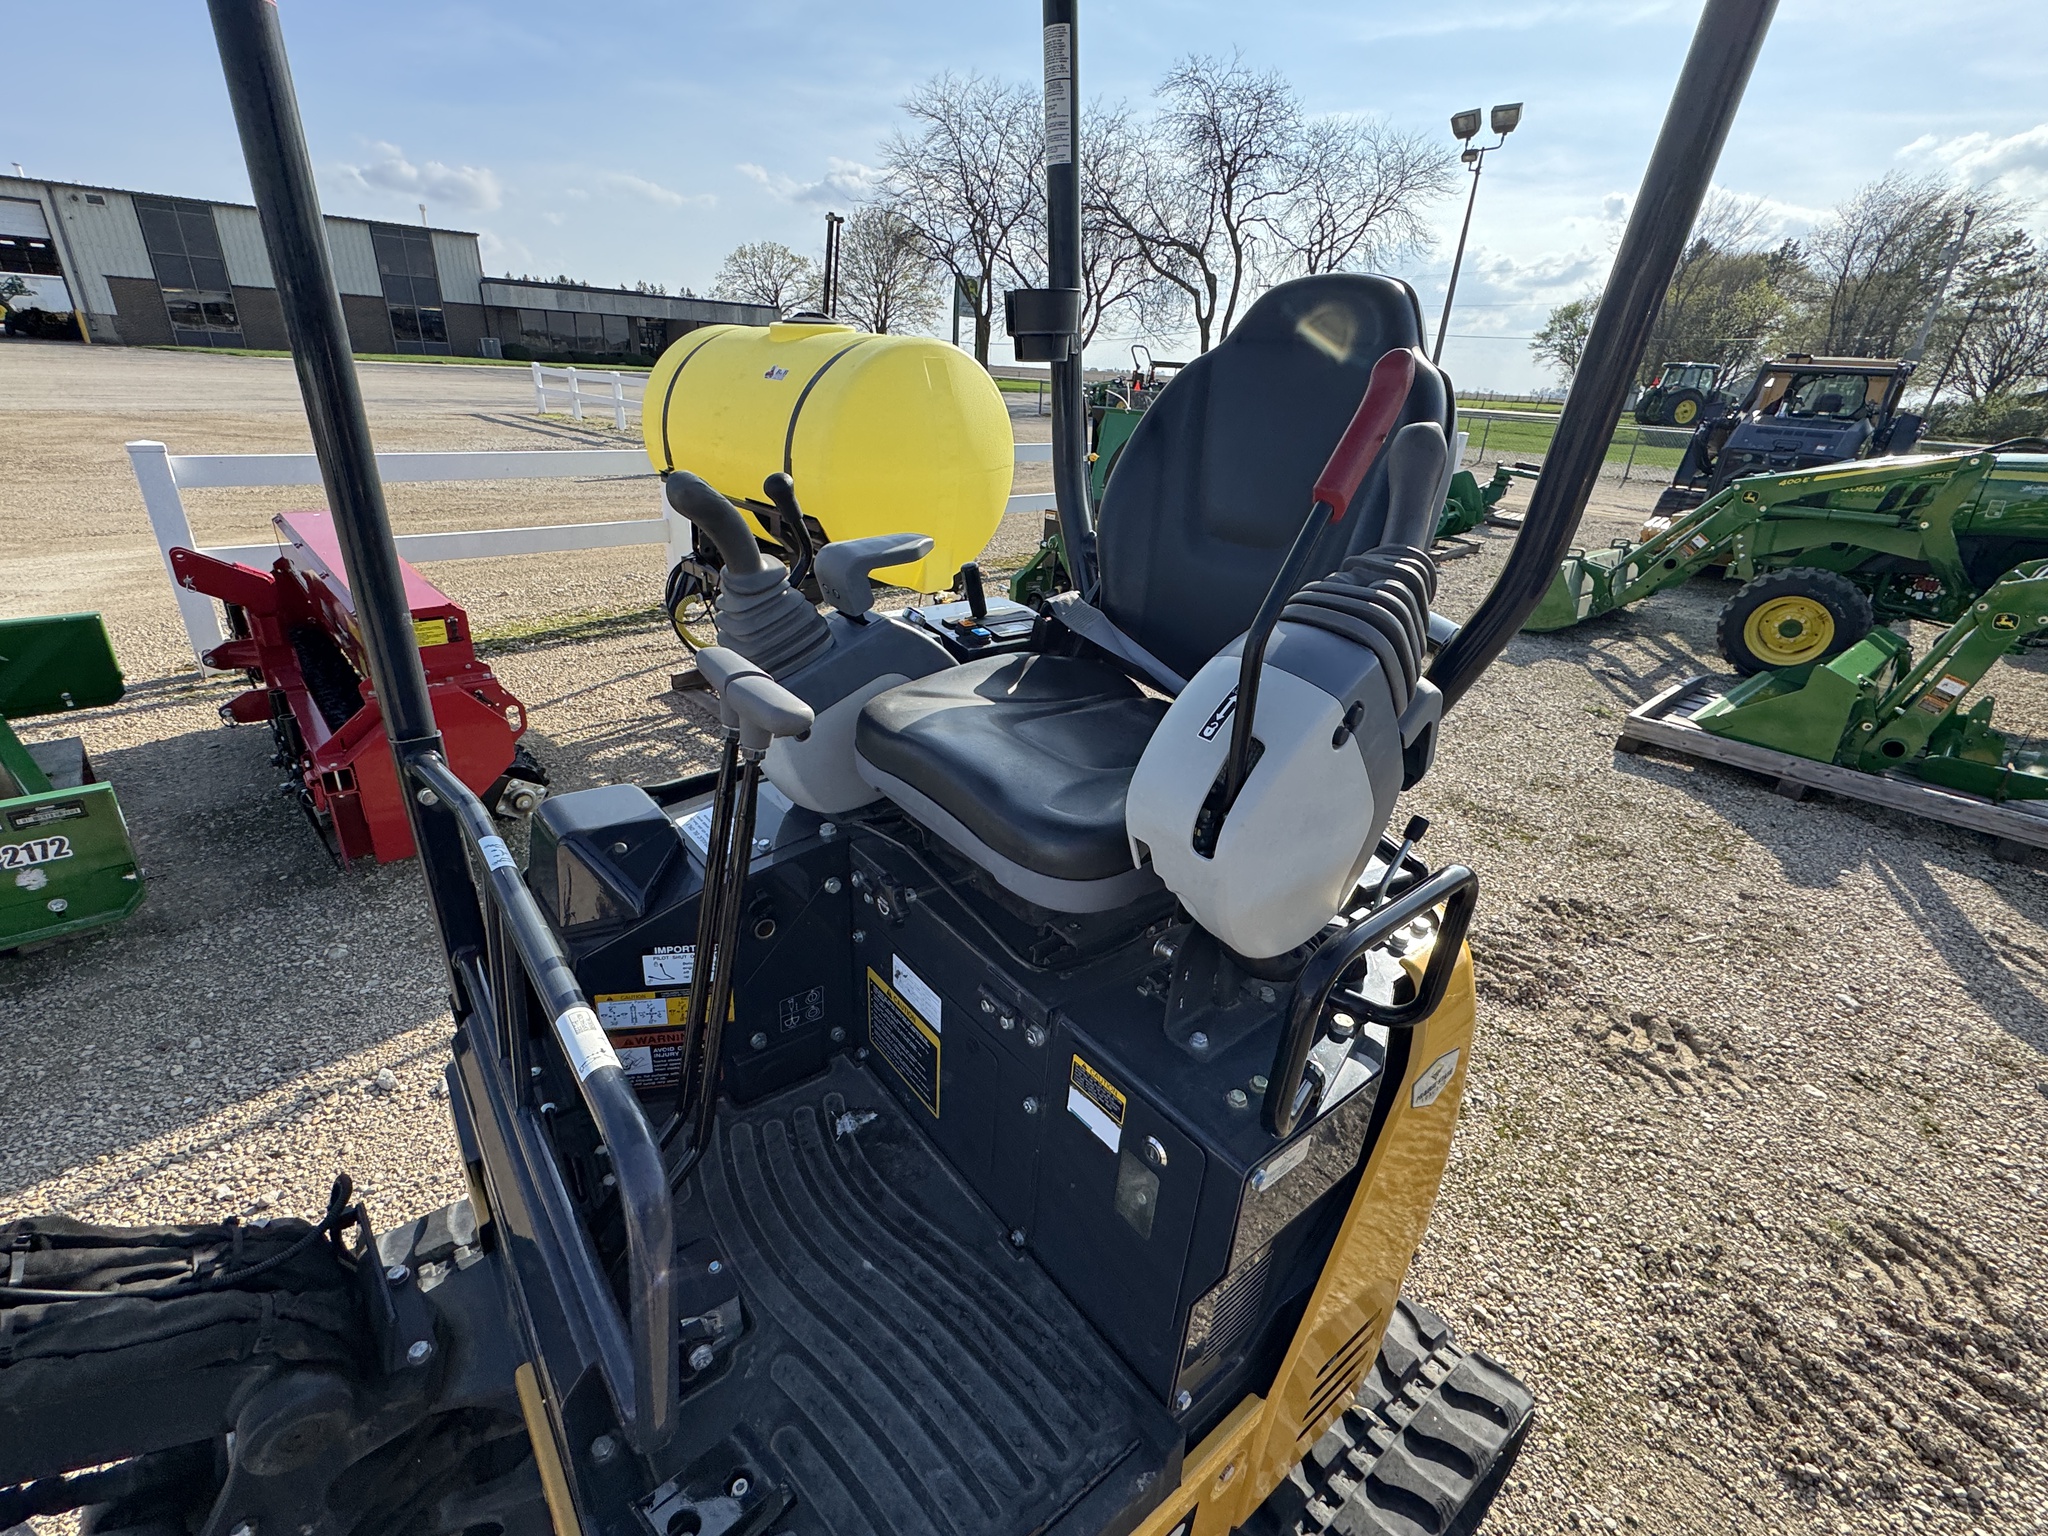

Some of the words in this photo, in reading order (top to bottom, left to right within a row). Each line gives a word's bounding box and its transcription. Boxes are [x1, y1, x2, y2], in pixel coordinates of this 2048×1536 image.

[1, 836, 71, 868] 2172
[653, 944, 697, 955] IMPORT
[892, 995, 917, 1024] CAUTION
[635, 1033, 685, 1047] WARNI
[1089, 1068, 1119, 1097] CAUTION
